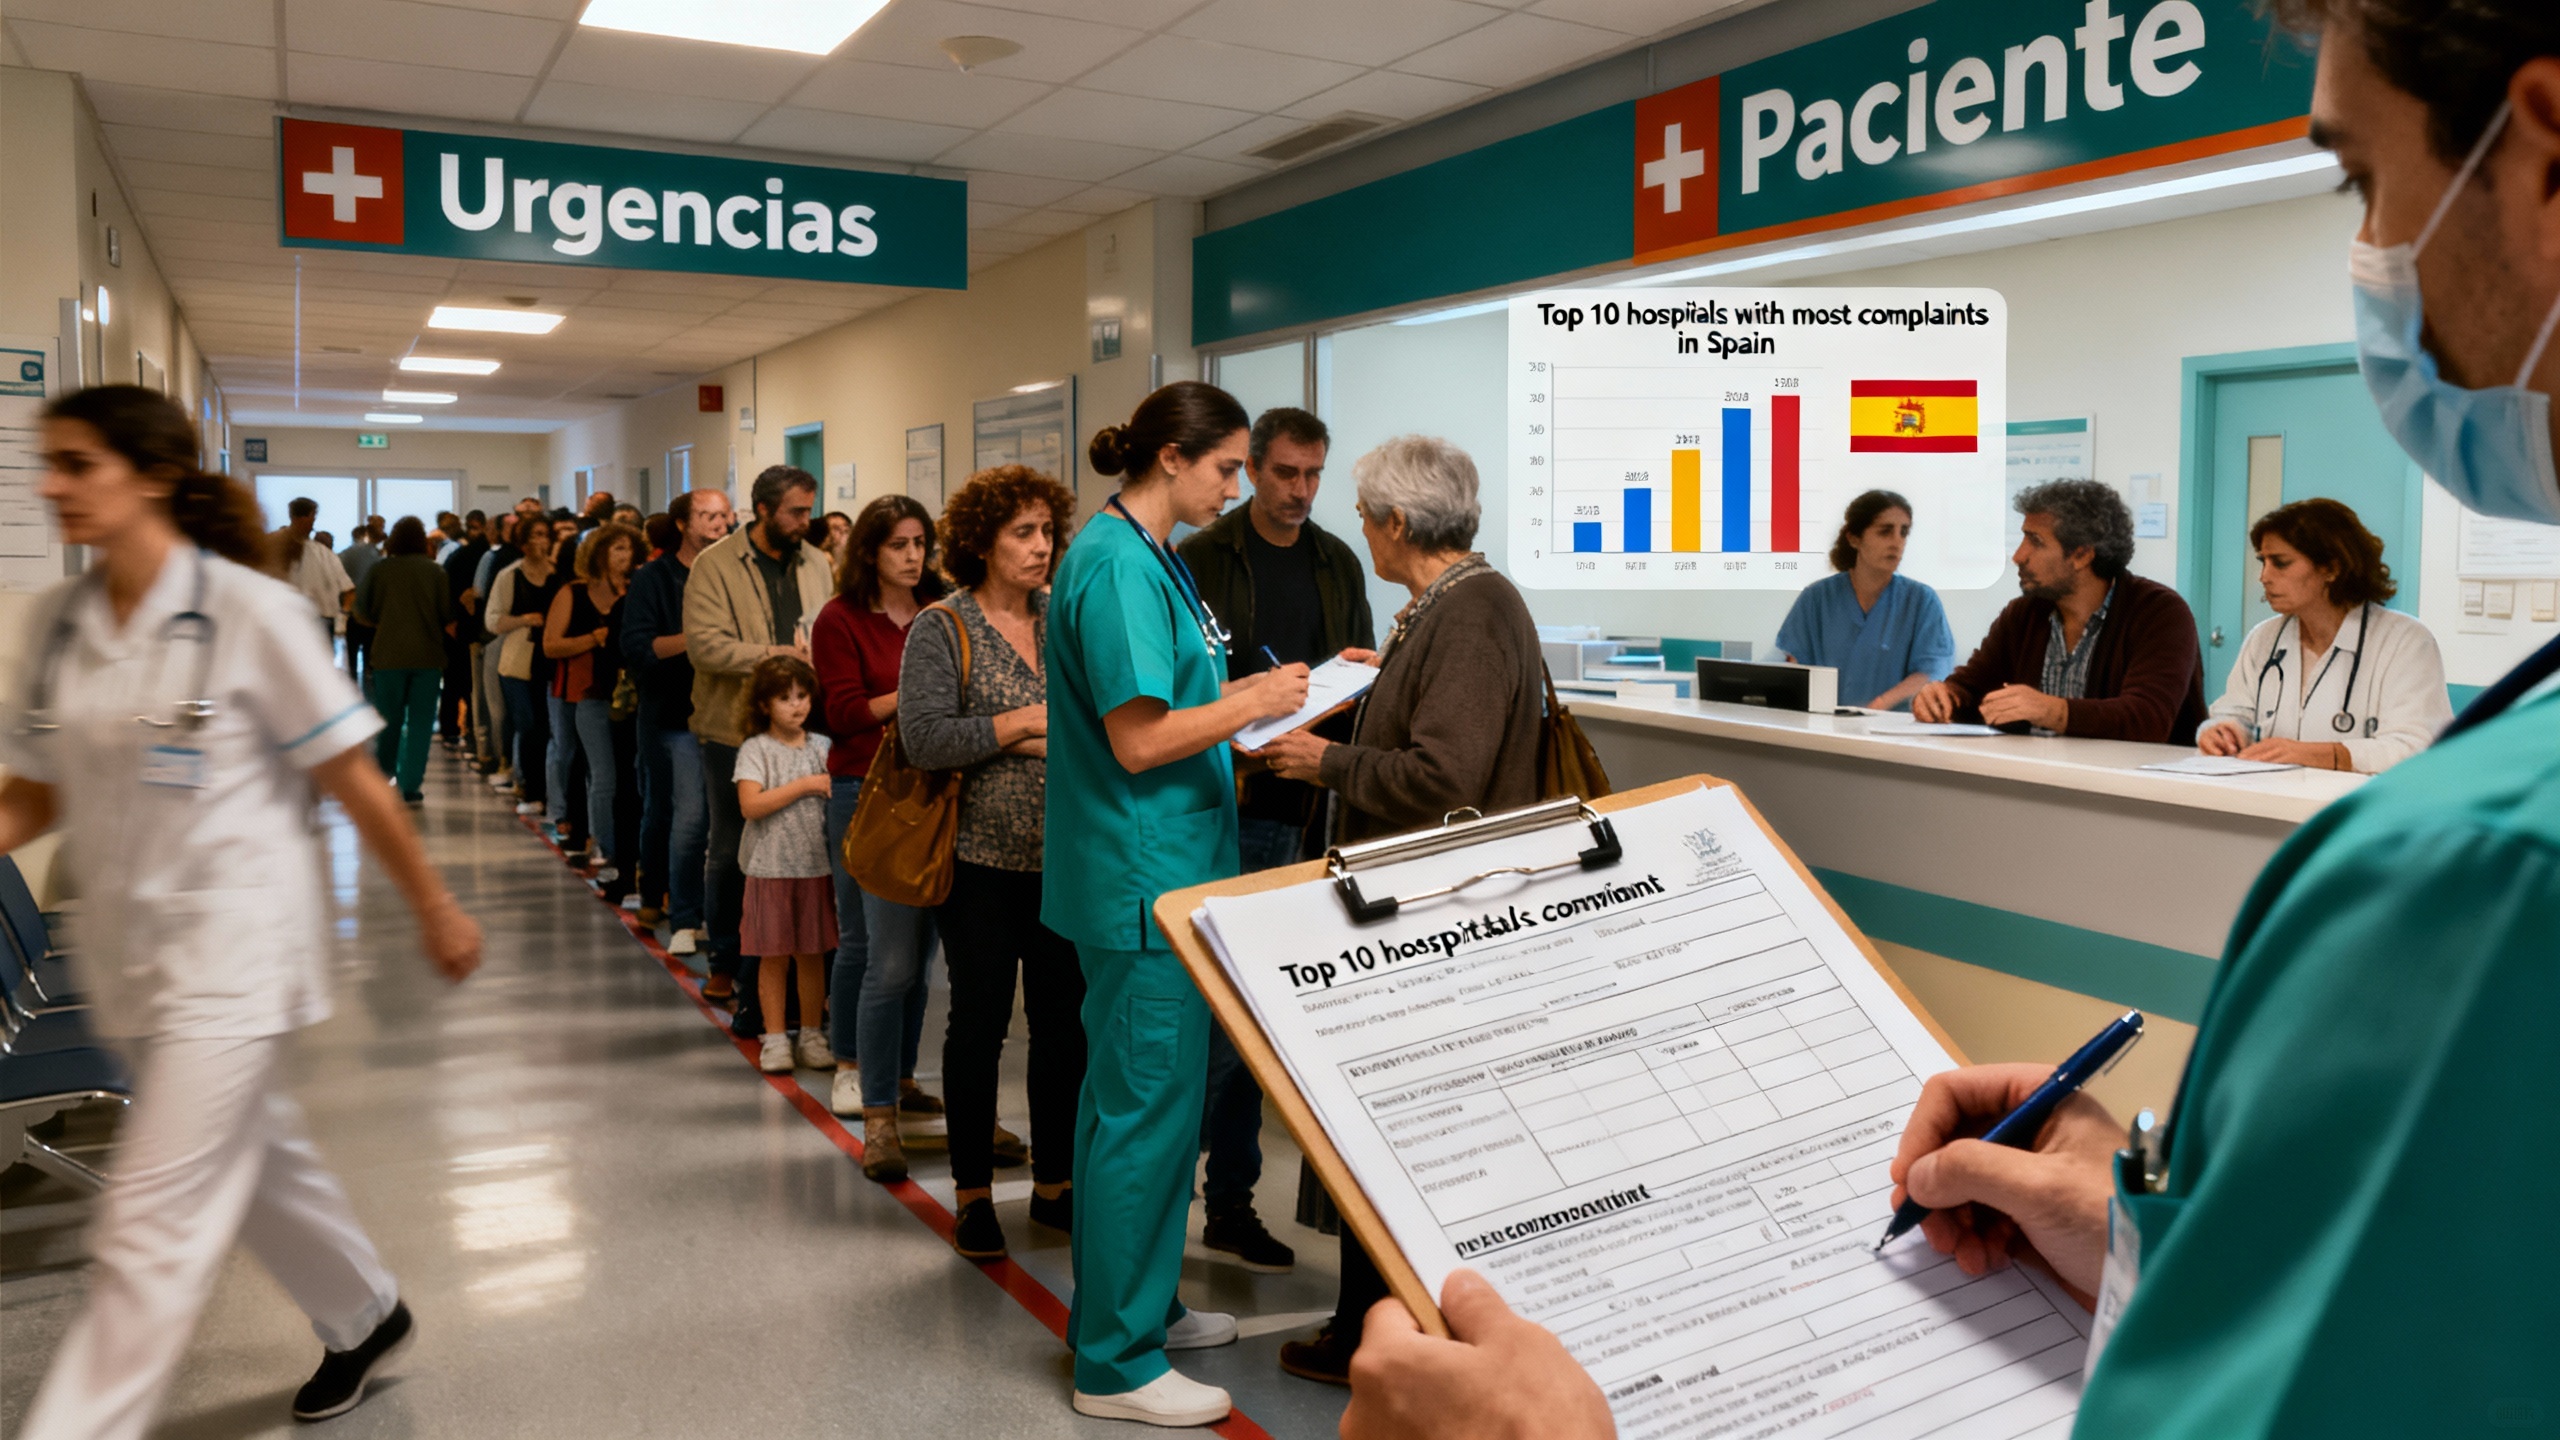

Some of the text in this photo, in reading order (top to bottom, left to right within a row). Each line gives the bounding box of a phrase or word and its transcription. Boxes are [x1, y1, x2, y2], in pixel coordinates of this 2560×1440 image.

[1741, 0, 2206, 195] Paciente
[440, 152, 878, 256] Urgencias
[1279, 961, 1337, 988] Top
[1339, 945, 1375, 974] 10
